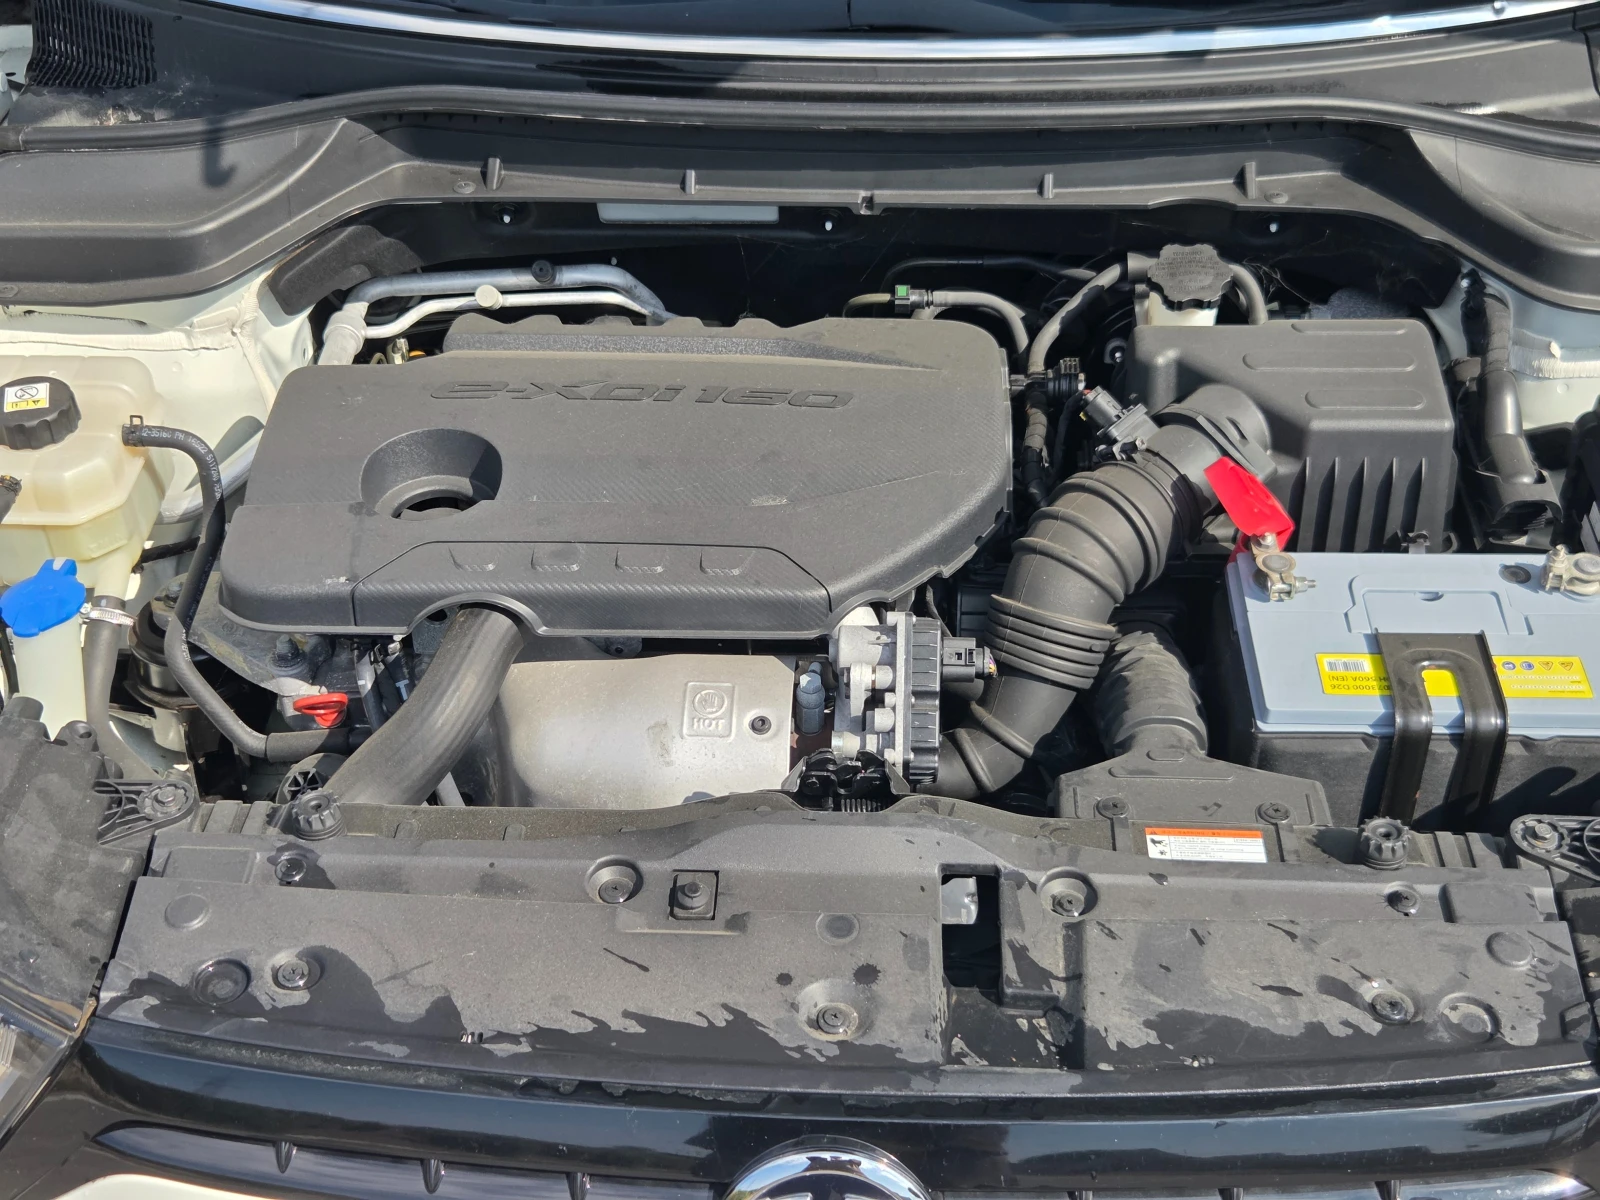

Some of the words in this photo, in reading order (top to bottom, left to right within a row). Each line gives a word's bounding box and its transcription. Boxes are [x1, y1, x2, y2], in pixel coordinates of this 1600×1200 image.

[695, 386, 853, 409] 160
[1327, 674, 1349, 682] (EN)
[692, 718, 726, 731] HOT
